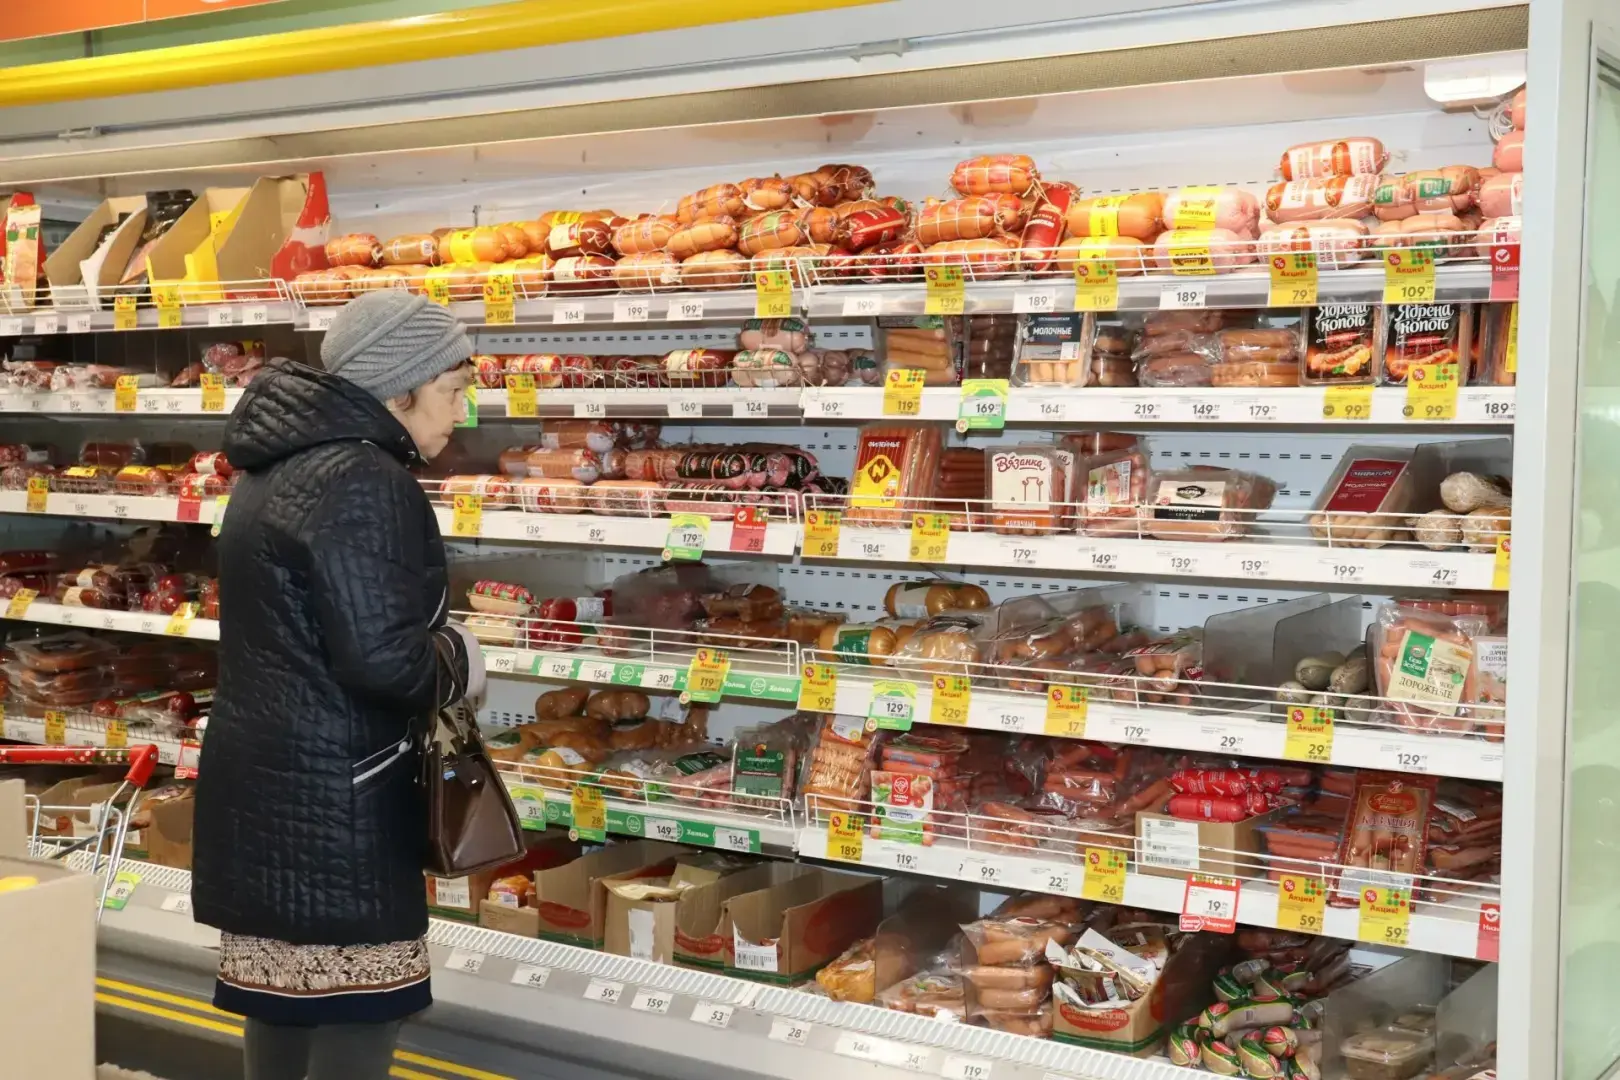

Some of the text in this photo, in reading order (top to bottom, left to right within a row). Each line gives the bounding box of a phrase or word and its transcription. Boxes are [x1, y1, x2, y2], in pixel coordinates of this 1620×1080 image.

[1292, 290, 1307, 300] 79
[1401, 286, 1425, 297] 109
[1028, 296, 1047, 306] 189
[1176, 292, 1197, 302] 189
[628, 307, 642, 316] 199
[681, 306, 697, 314] 199
[565, 312, 578, 320] 164
[1033, 327, 1072, 336] МОЛОЧНЫЕ
[586, 404, 600, 413] 134
[680, 402, 696, 412] 169
[746, 402, 762, 412] 124
[821, 402, 838, 412] 169
[897, 400, 913, 410] 119
[976, 403, 995, 414] 169
[1040, 403, 1060, 414] 164
[1134, 404, 1154, 415] 219
[1192, 404, 1213, 415] 149
[1345, 404, 1362, 415] 99
[1484, 402, 1509, 414] 189
[1249, 405, 1270, 416] 179
[1425, 405, 1443, 416] 99
[995, 455, 1046, 473] Вязанка
[526, 526, 539, 534] 139
[589, 529, 600, 537] 89
[682, 533, 698, 542] 179
[748, 538, 759, 547] 28
[820, 542, 833, 552] 69
[862, 544, 880, 553] 184
[928, 546, 940, 555] 89
[1012, 549, 1031, 559] 179
[1092, 554, 1110, 564] 149
[1171, 558, 1190, 568] 139
[1241, 560, 1262, 570] 139
[1333, 565, 1356, 576] 199
[1432, 569, 1449, 580] 47
[495, 658, 509, 667] 199
[552, 664, 566, 672] 129
[593, 670, 607, 678] 154
[658, 674, 669, 683] 30
[700, 678, 714, 686] 119
[818, 696, 830, 706] 99
[886, 702, 903, 712] 129
[942, 707, 960, 718] 229
[1000, 714, 1018, 724] 159
[1068, 722, 1079, 730] 17
[1124, 726, 1144, 736] 179
[1297, 724, 1324, 732] Акция!
[1220, 736, 1236, 747] 29
[1308, 744, 1324, 755] 29
[1397, 753, 1420, 765] 129
[528, 807, 537, 816] 31
[591, 816, 602, 826] 28
[656, 825, 672, 835] 149
[686, 829, 710, 839] Халяль
[728, 835, 744, 845] 134
[840, 845, 857, 856] 189
[896, 854, 912, 864] 119
[981, 866, 995, 877] 99
[1094, 866, 1117, 874] Акция!
[1049, 876, 1062, 887] 22
[115, 888, 125, 896] 89
[1103, 884, 1116, 895] 26
[1289, 893, 1315, 902] Акция!
[1207, 900, 1221, 910] 19
[1370, 904, 1398, 913] Акция!
[1299, 915, 1316, 927] 59
[1386, 926, 1402, 938] 59
[464, 959, 476, 968] 55
[529, 974, 541, 982] 54
[602, 988, 615, 998] 59
[646, 998, 663, 1008] 159
[711, 1010, 724, 1021] 53
[788, 1028, 802, 1038] 28
[964, 1064, 982, 1076] 119
